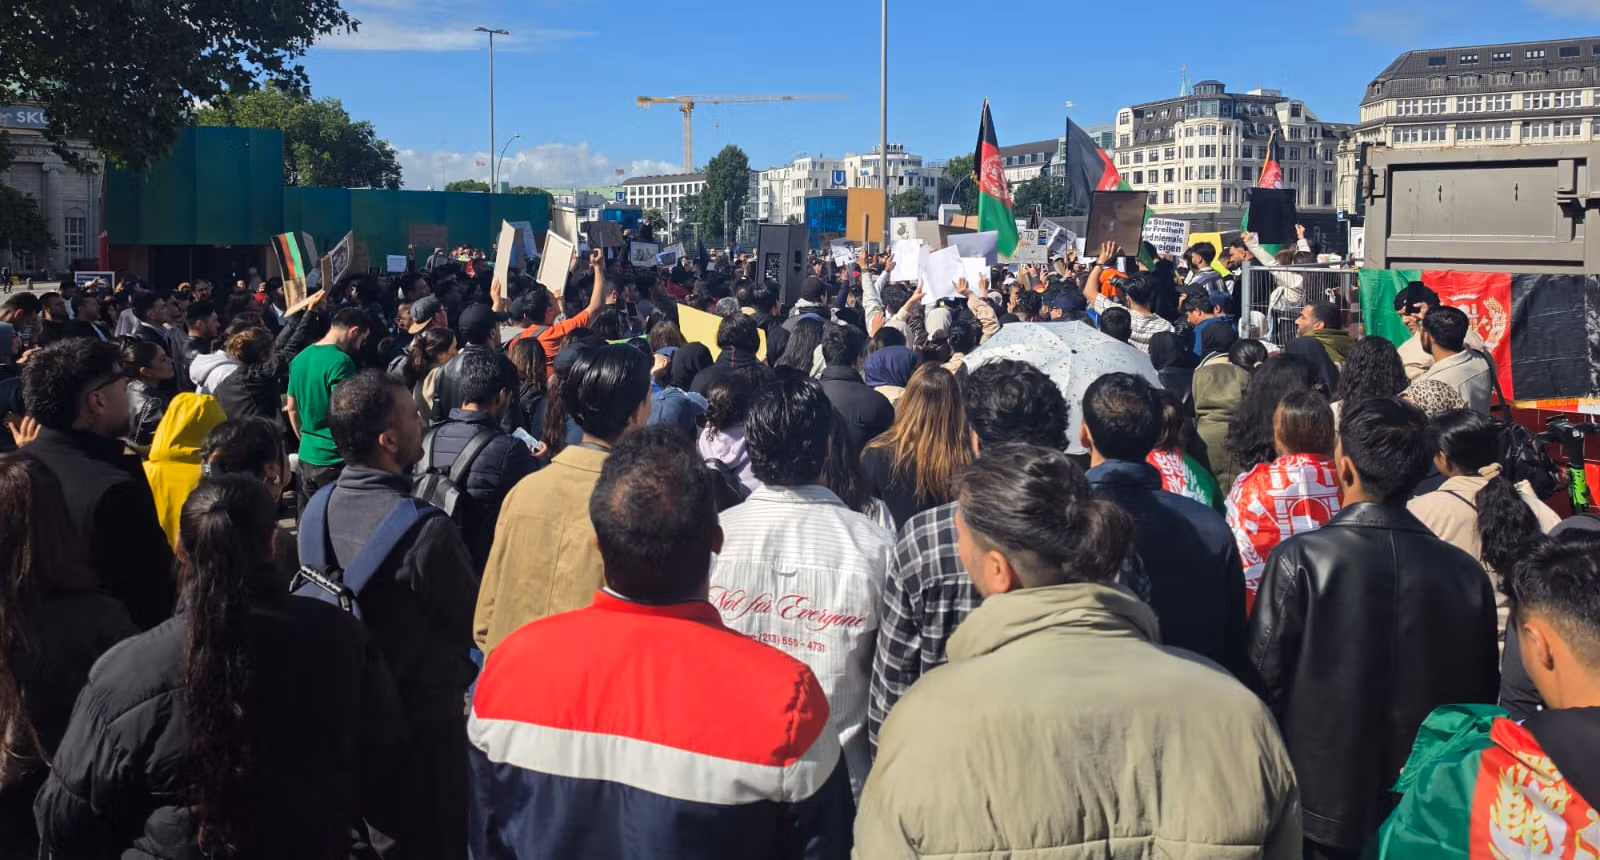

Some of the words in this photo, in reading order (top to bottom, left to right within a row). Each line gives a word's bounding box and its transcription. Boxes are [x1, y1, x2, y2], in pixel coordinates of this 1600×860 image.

[833, 171, 844, 185] U
[1153, 218, 1185, 227] Stimme
[1153, 226, 1185, 235] Freiheit
[1154, 233, 1183, 243] niemals
[710, 585, 747, 612] Not
[721, 592, 773, 621] for
[777, 594, 868, 631] Everyone
[807, 639, 825, 653] 4731
